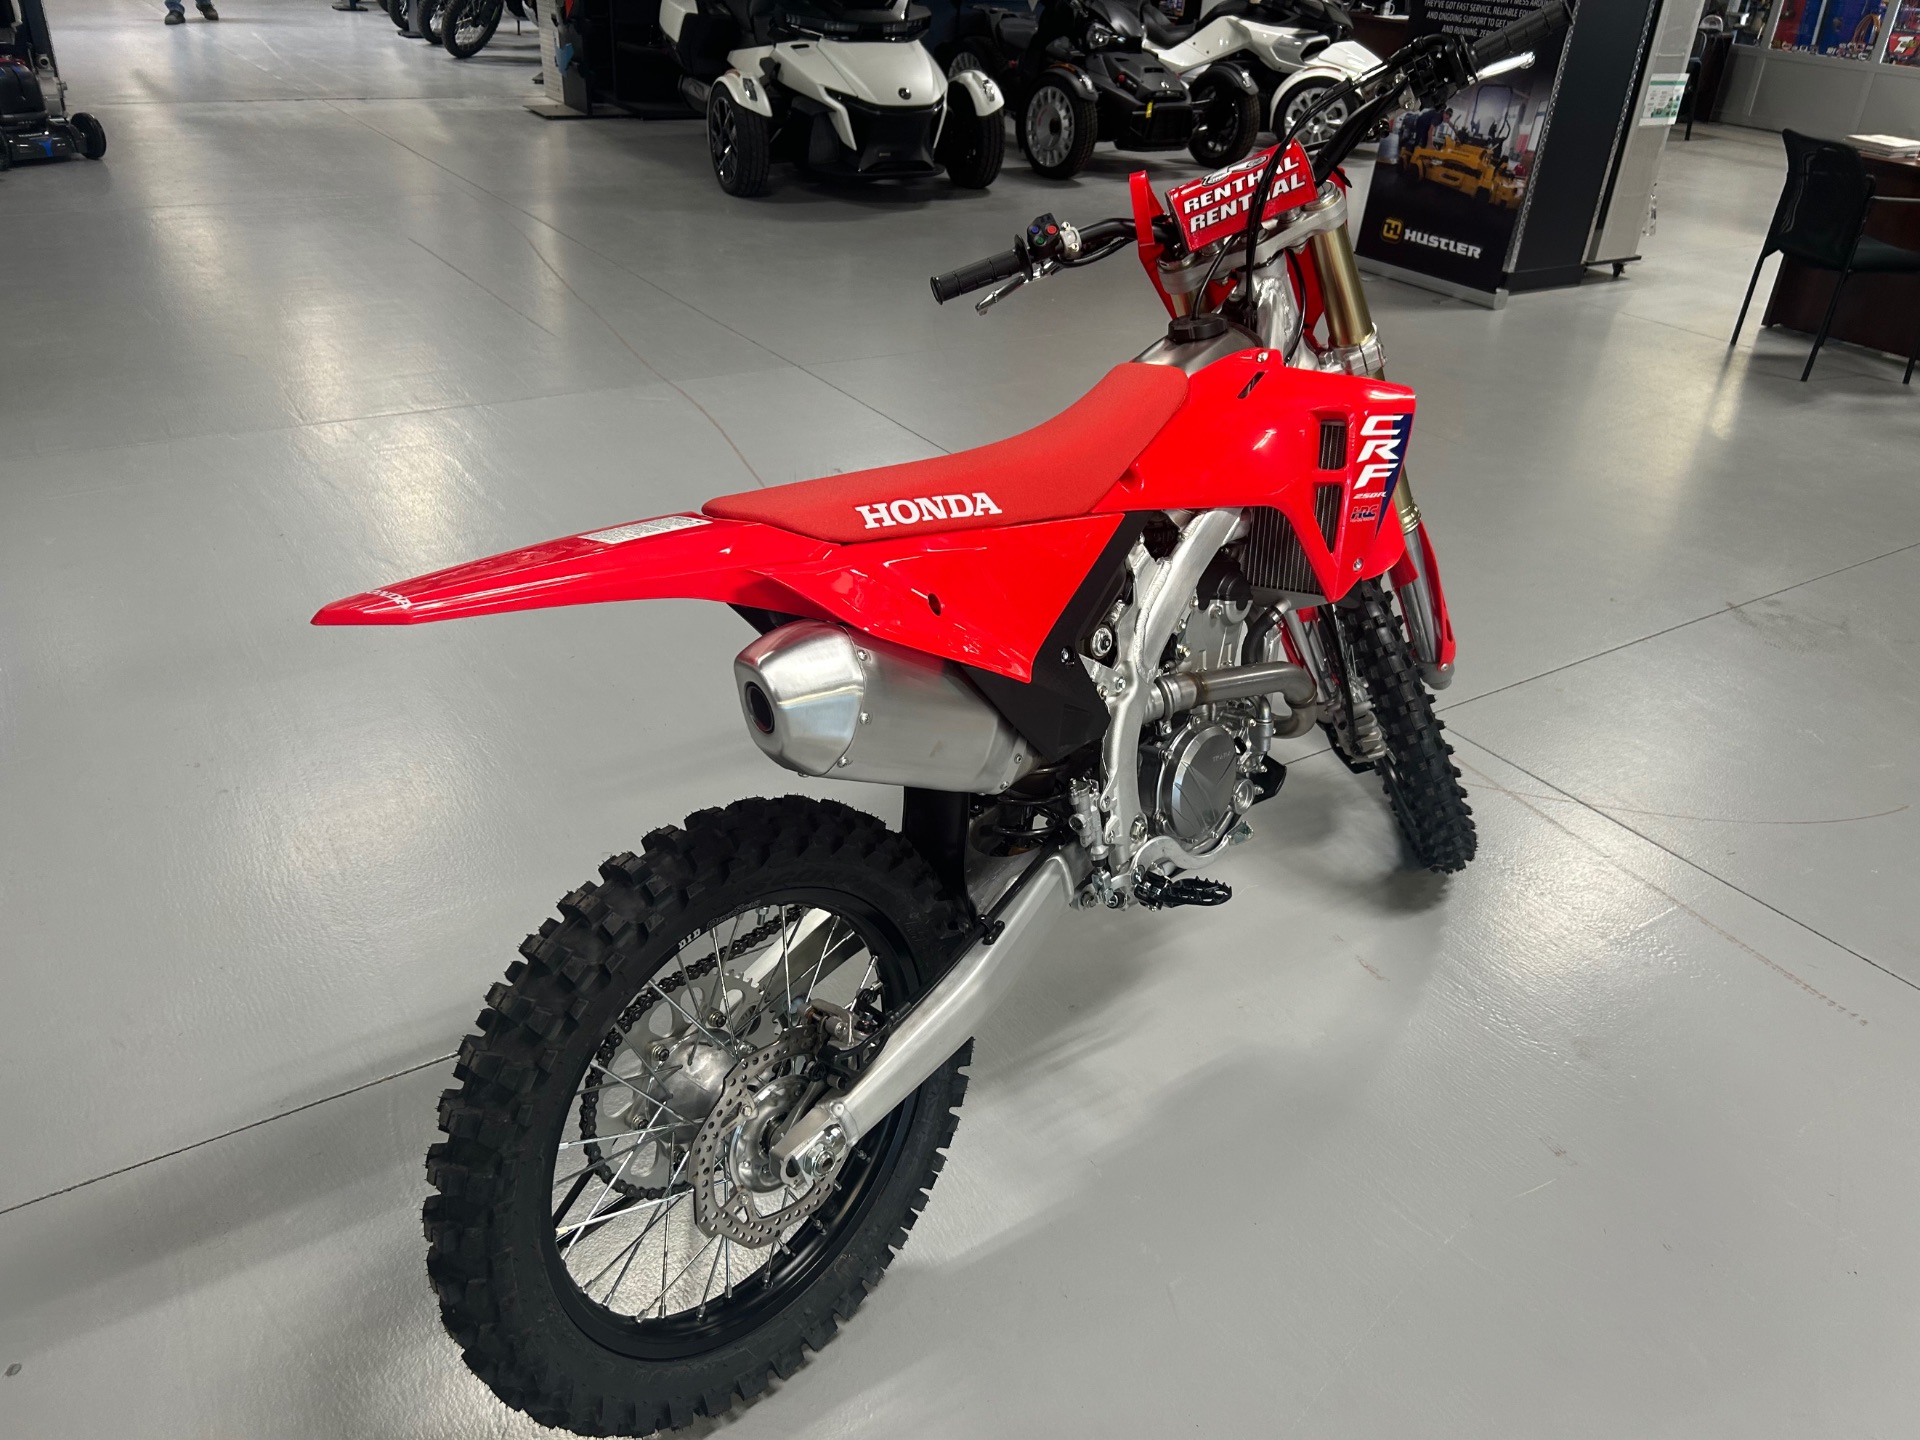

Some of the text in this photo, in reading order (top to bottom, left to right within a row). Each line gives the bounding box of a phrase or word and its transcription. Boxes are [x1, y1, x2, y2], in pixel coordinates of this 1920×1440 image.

[1426, 10, 1439, 20] AND
[1438, 12, 1463, 23] ONGOING
[1462, 14, 1488, 26] SUPPORT
[1487, 17, 1495, 27] TO
[1495, 18, 1507, 28] GET
[1445, 1, 1457, 10] GOT
[1456, 2, 1470, 11] FAST
[1493, 6, 1519, 18] RELIABLE
[1441, 24, 1454, 34] AND
[1190, 173, 1305, 234] RENTAL
[1404, 228, 1481, 259] HUSTLER
[1353, 415, 1404, 490] CRF
[1353, 491, 1388, 500] 250R
[855, 492, 1003, 530] HONDA
